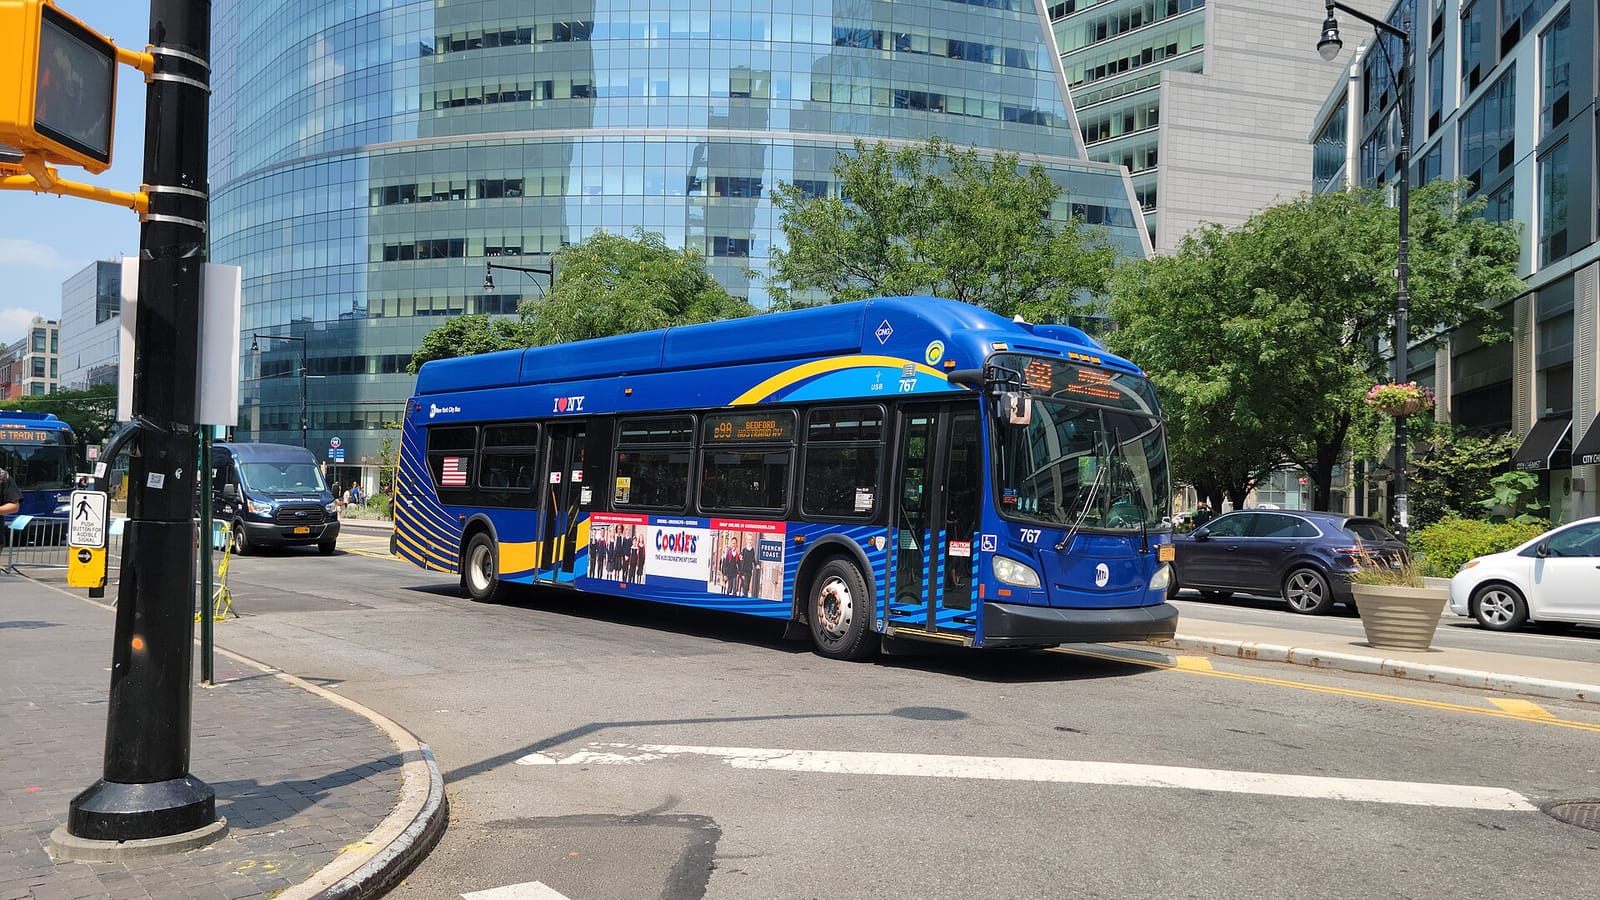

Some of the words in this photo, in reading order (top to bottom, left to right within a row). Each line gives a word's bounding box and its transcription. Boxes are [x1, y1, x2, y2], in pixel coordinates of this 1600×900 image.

[899, 379, 917, 392] 767
[566, 396, 585, 412] NY
[714, 422, 732, 439] B98
[745, 421, 776, 429] BEDFORD
[9, 431, 34, 440] TRAIN
[36, 432, 47, 441] TO
[1583, 455, 1593, 464] CITY
[1020, 528, 1042, 544] 767
[761, 544, 782, 552] FRENCH
